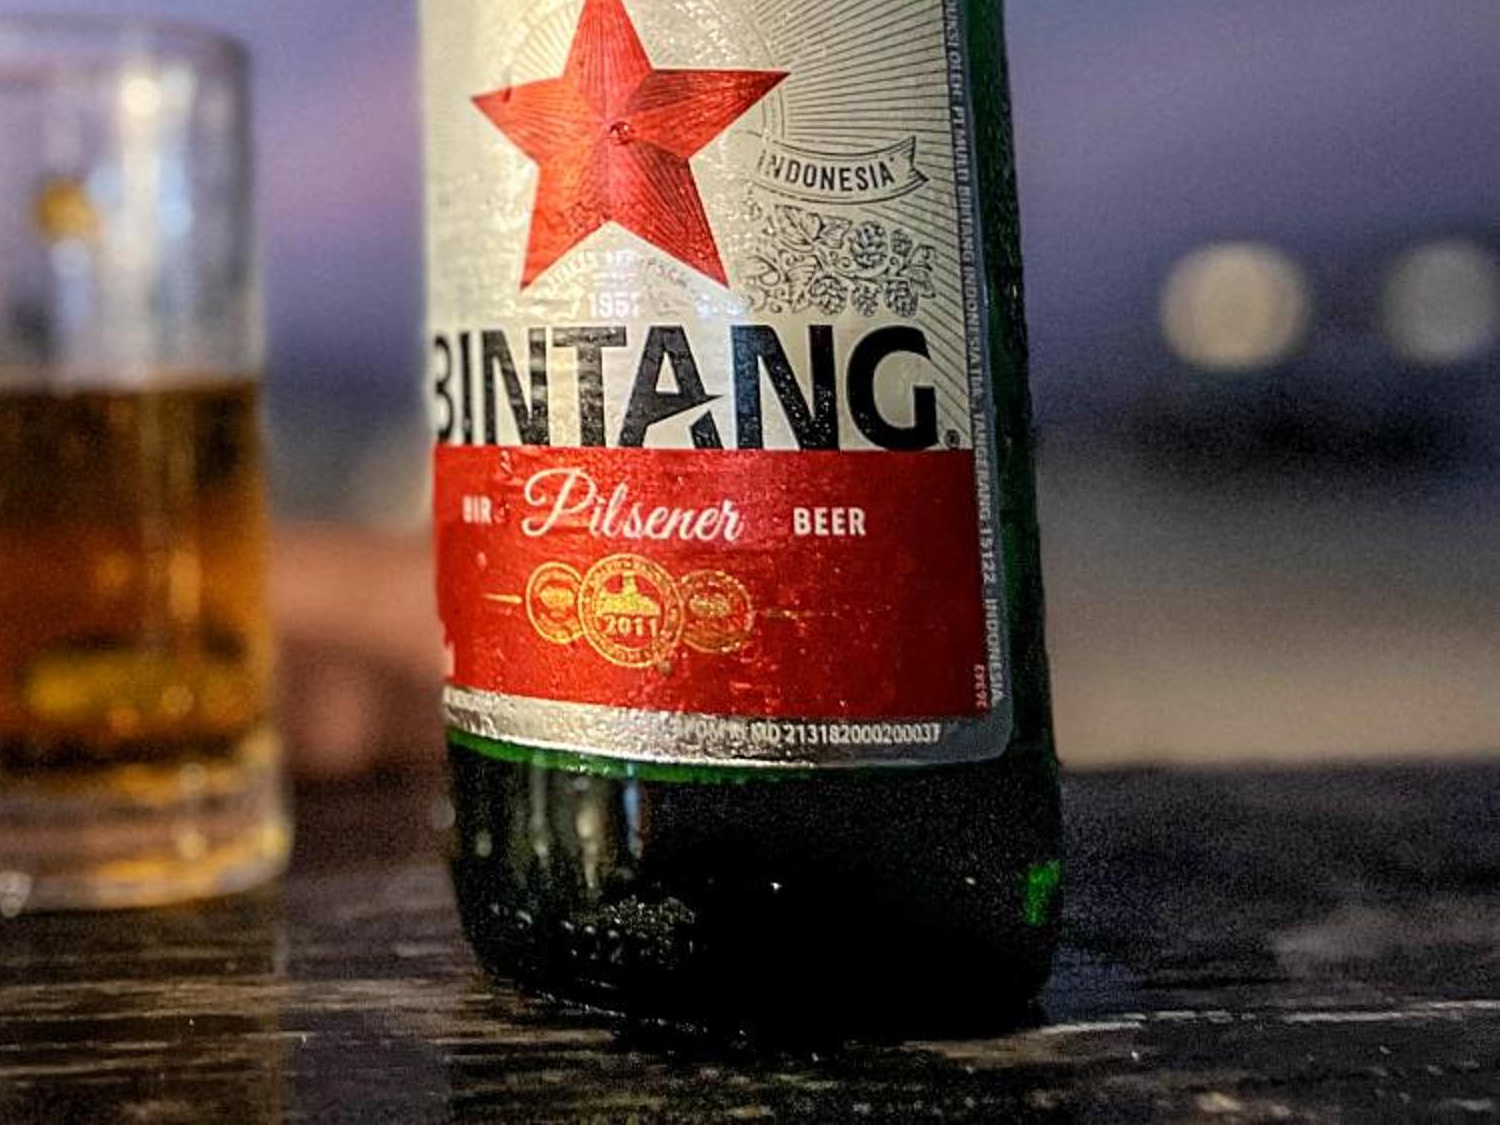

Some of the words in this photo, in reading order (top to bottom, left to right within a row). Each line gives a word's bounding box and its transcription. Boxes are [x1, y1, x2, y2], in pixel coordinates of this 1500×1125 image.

[756, 148, 896, 193] INDONESIA
[433, 324, 938, 452] BINTANG
[521, 467, 743, 542] Pilsener
[793, 506, 867, 537] BEER
[604, 615, 658, 639] 2011
